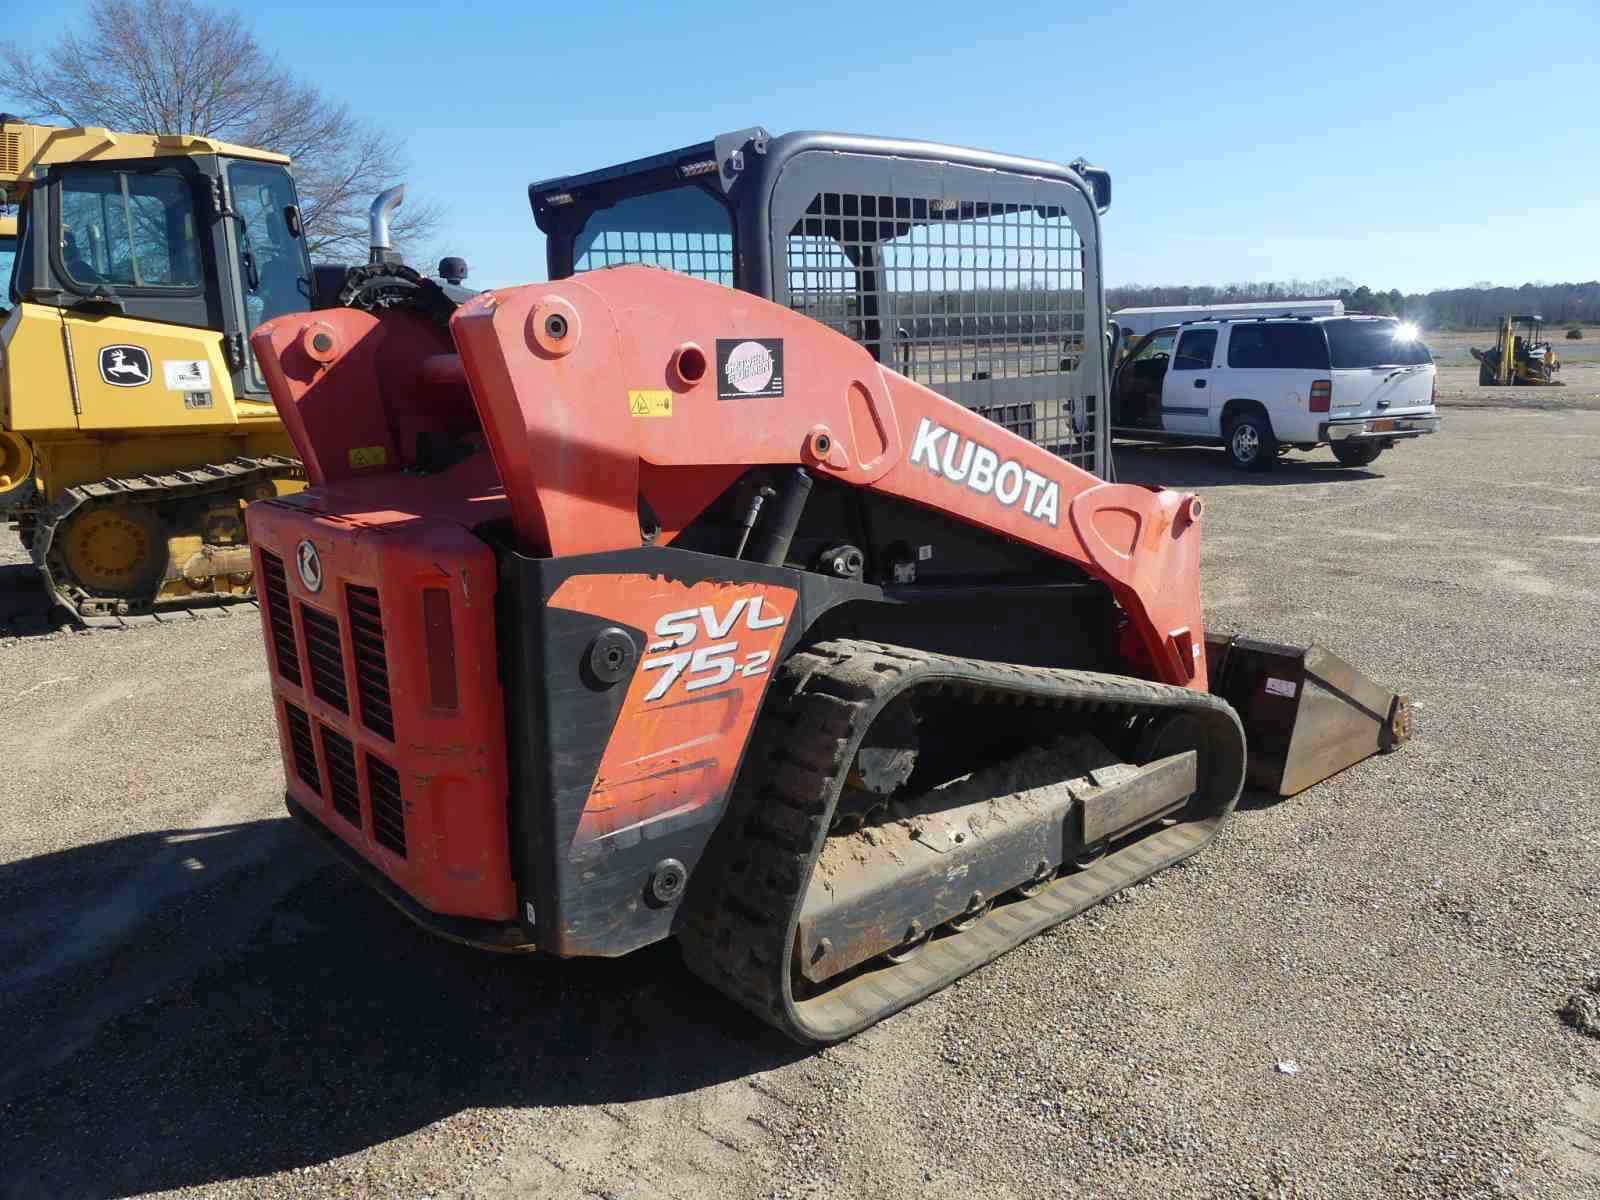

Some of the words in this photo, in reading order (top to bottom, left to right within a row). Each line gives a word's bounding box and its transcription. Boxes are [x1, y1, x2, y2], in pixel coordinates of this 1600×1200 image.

[911, 416, 1059, 526] KUBOTA
[650, 595, 785, 653] SVL
[642, 641, 771, 702] 75-2
